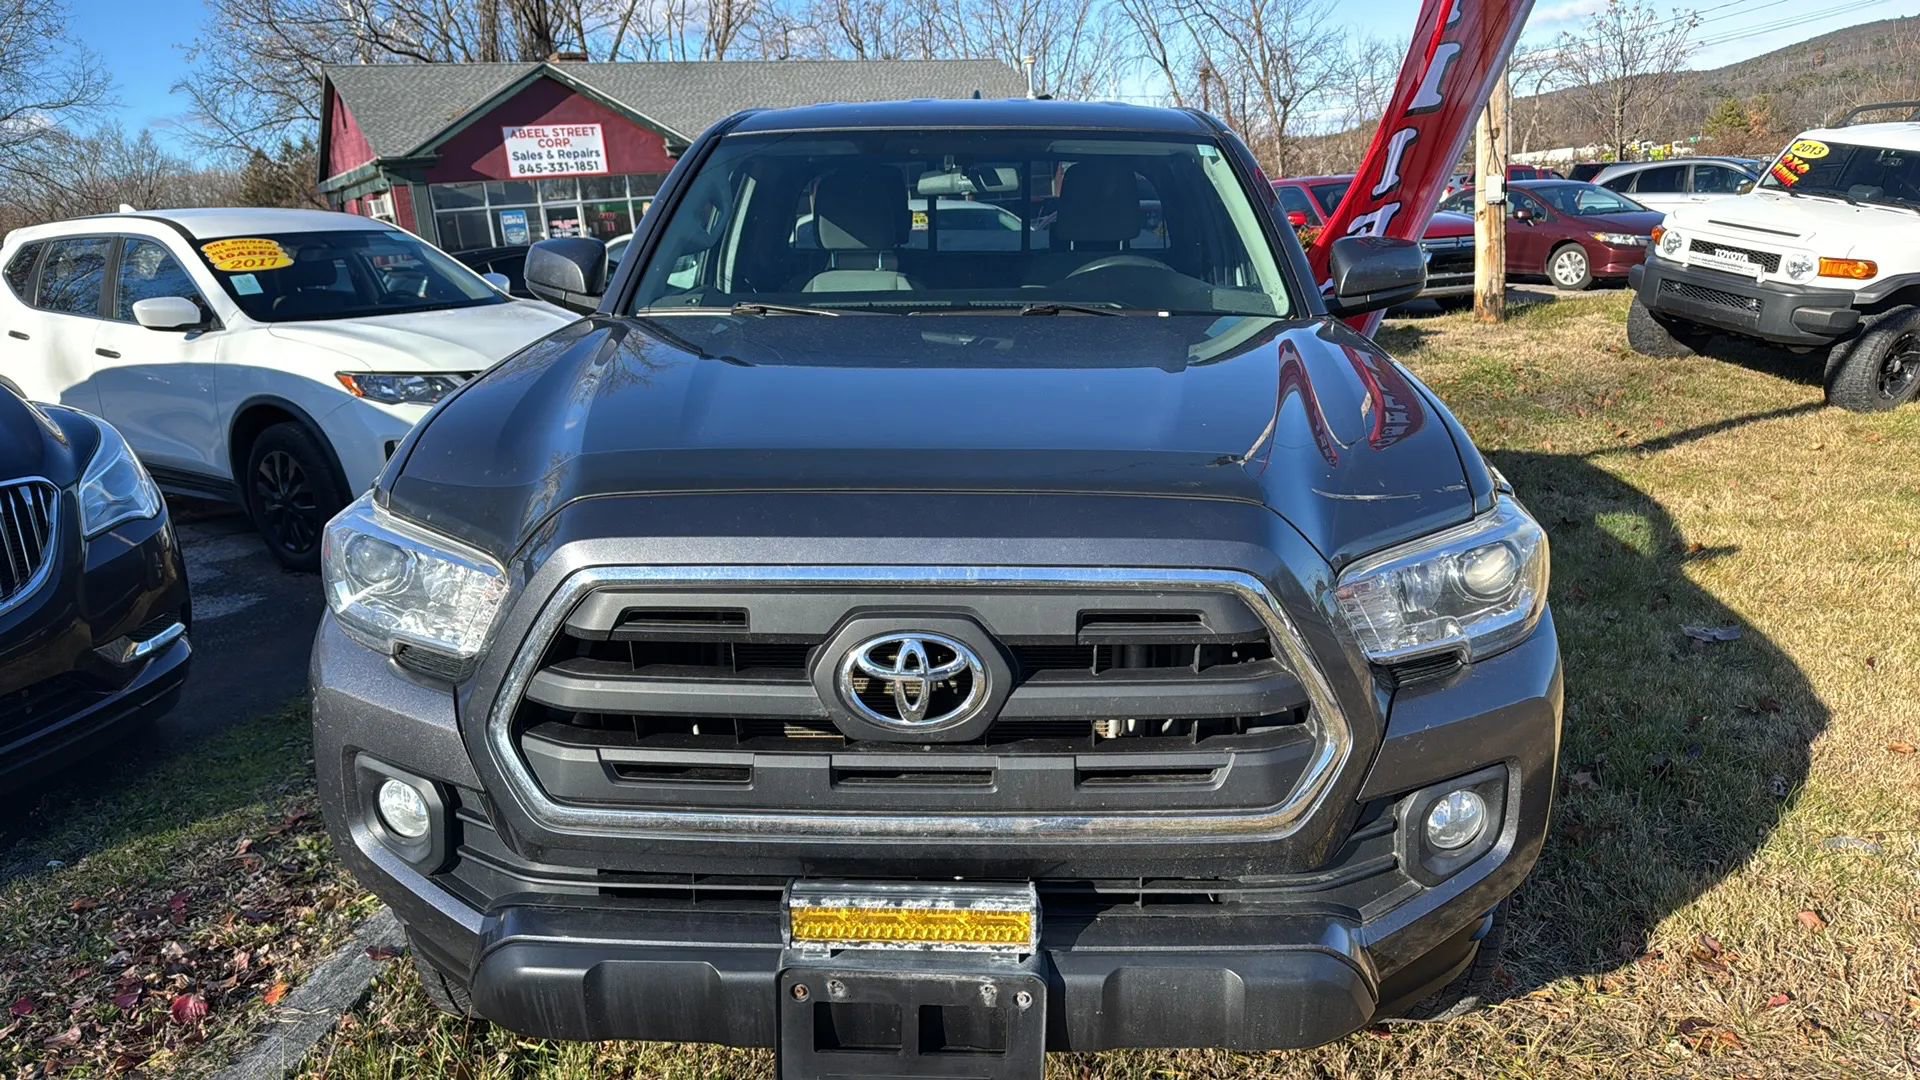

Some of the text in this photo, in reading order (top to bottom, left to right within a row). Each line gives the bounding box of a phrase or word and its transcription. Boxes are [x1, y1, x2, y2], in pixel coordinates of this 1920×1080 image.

[510, 126, 596, 139] ABEEL STREET
[537, 138, 573, 148] CORP.
[1795, 143, 1825, 155] 2013
[512, 149, 601, 161] Sales & Repairs
[518, 161, 599, 174] 845-331-1851
[206, 242, 226, 250] ONE
[218, 250, 279, 260] LOADED
[1714, 248, 1749, 263] TOYOTA
[230, 257, 279, 269] 2017
